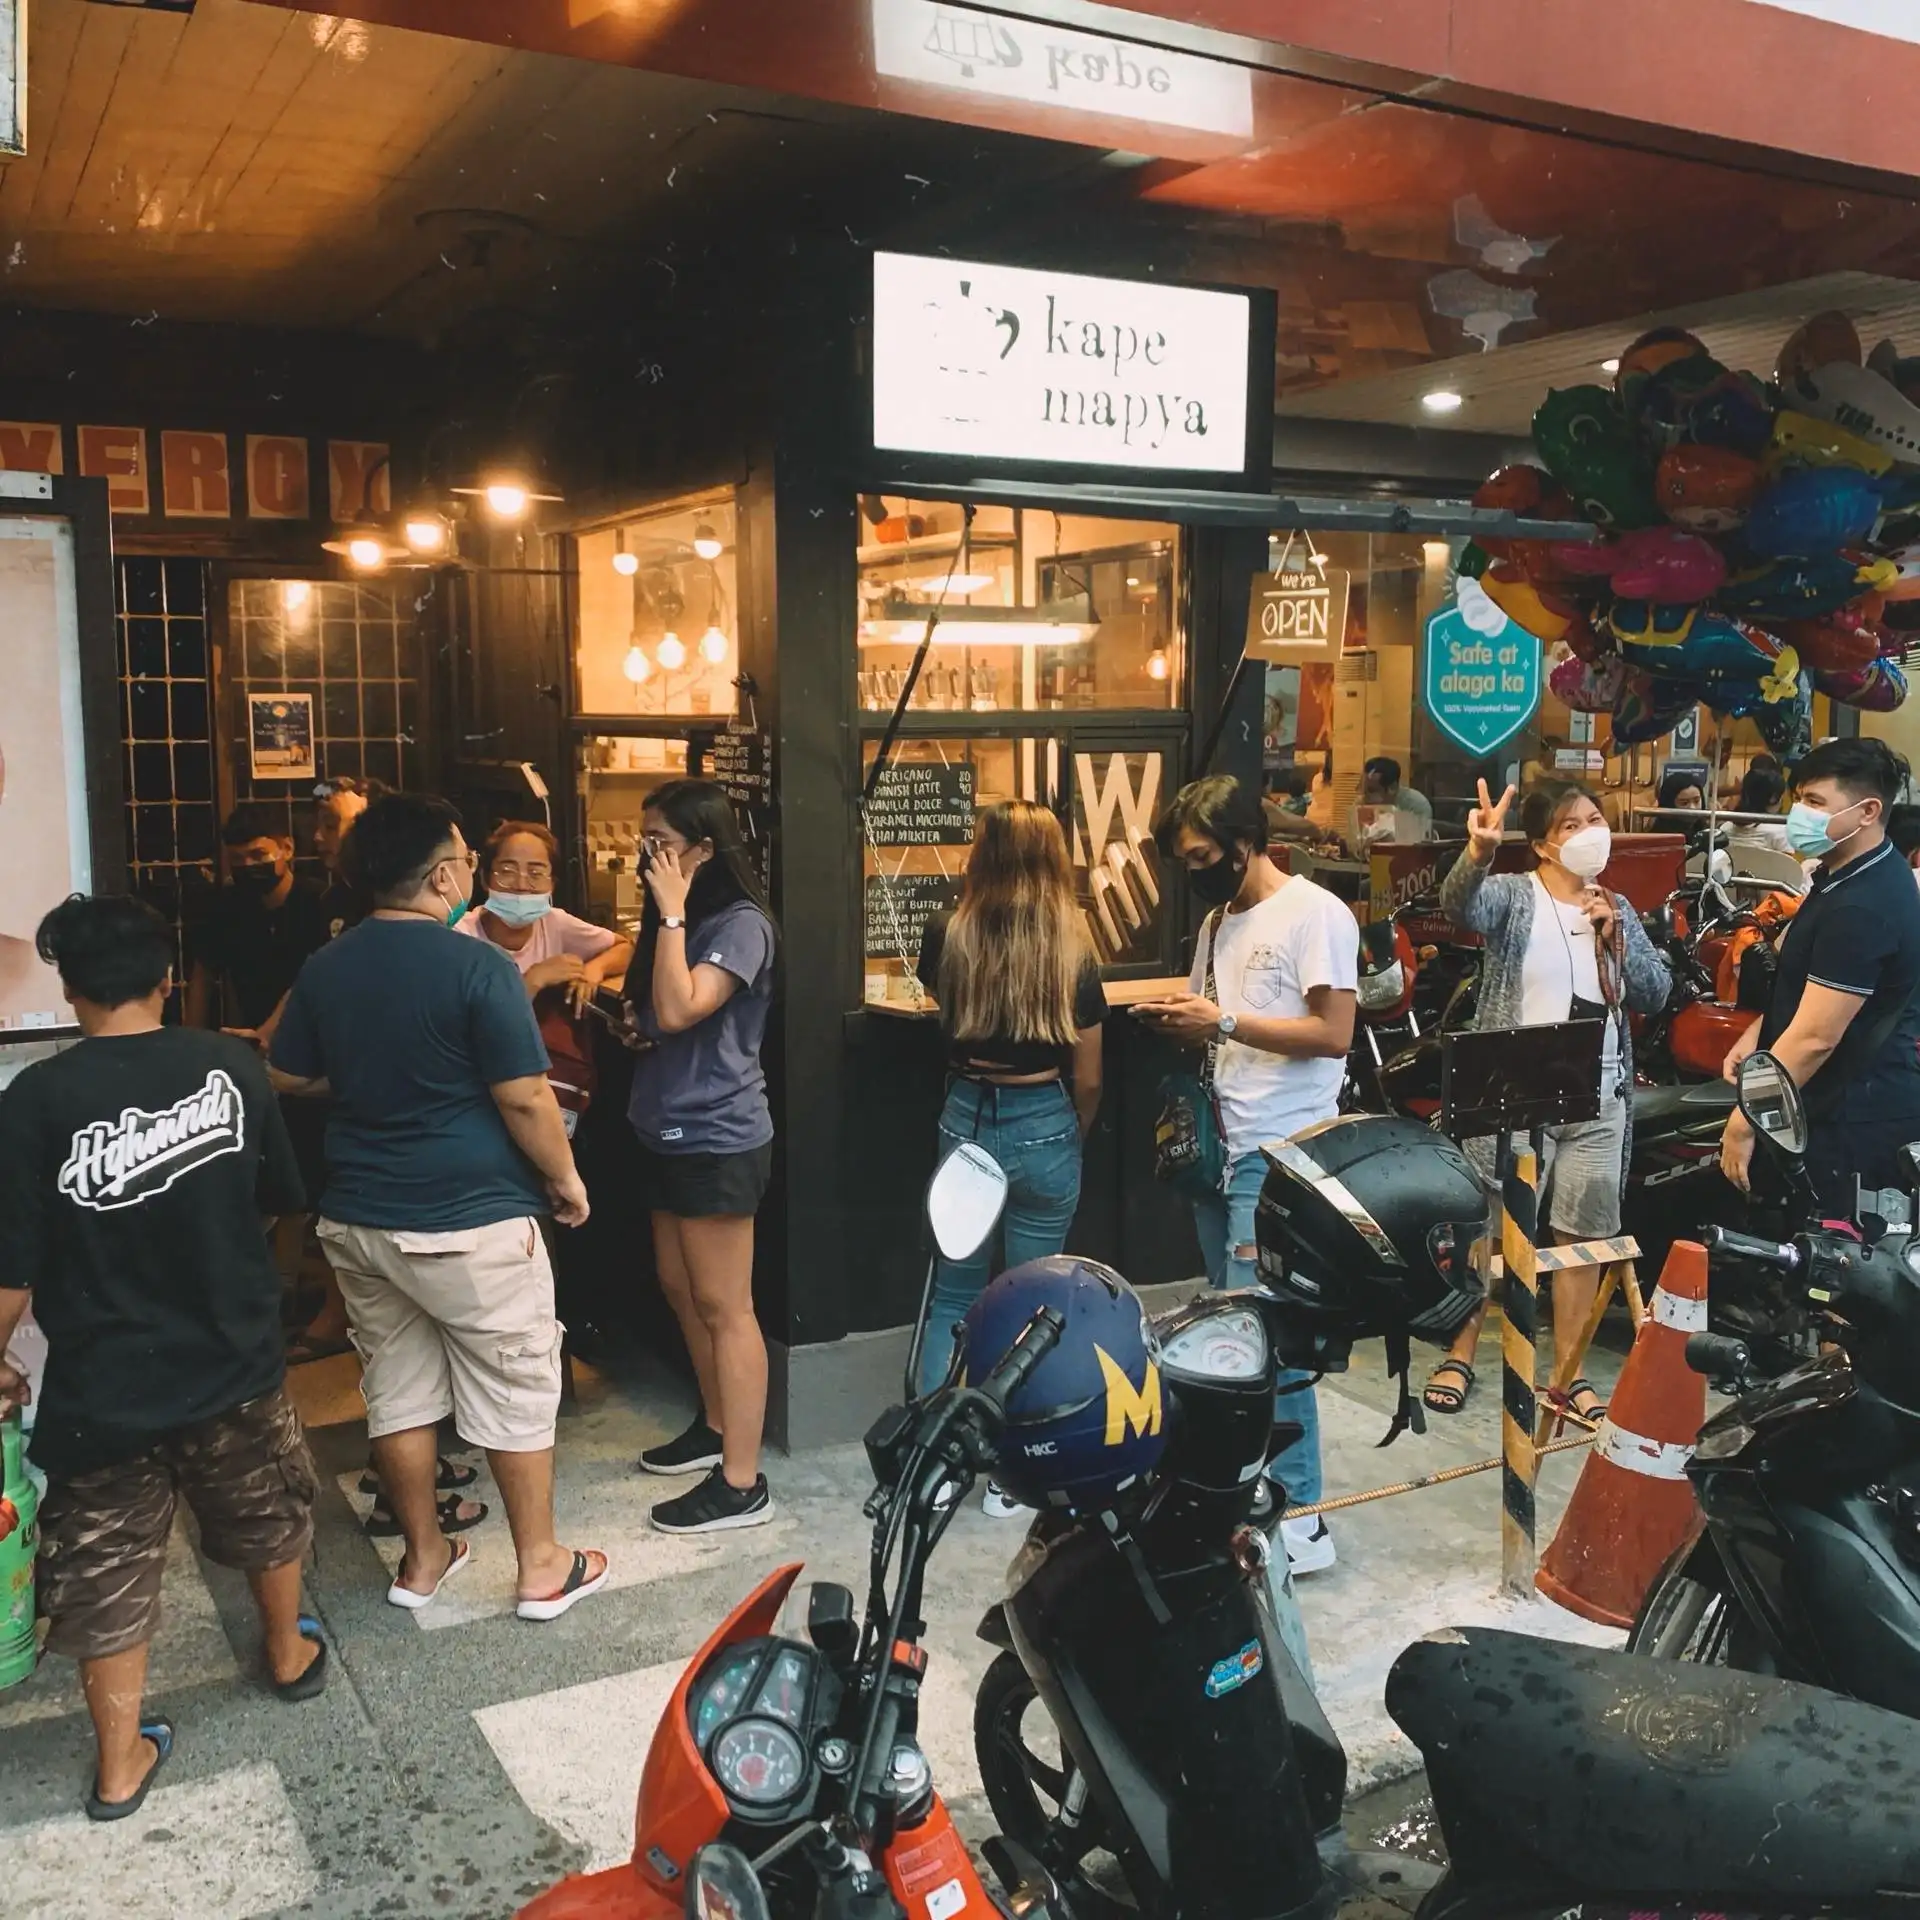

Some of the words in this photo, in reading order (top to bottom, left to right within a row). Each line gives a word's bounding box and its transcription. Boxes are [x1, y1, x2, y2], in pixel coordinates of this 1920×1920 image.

[1046, 294, 1167, 378] kape
[1042, 387, 1208, 450] mapya
[1281, 572, 1317, 589] we're
[1261, 597, 1330, 637] OPEN
[1449, 640, 1494, 665] Safe
[1498, 644, 1519, 665] at
[1440, 669, 1496, 699] alaga
[1502, 669, 1525, 693] ka
[868, 799, 910, 812] VANILLA
[914, 799, 942, 811] DOLCE
[909, 900, 944, 911] BUTTER
[1024, 1441, 1058, 1457] HKC
